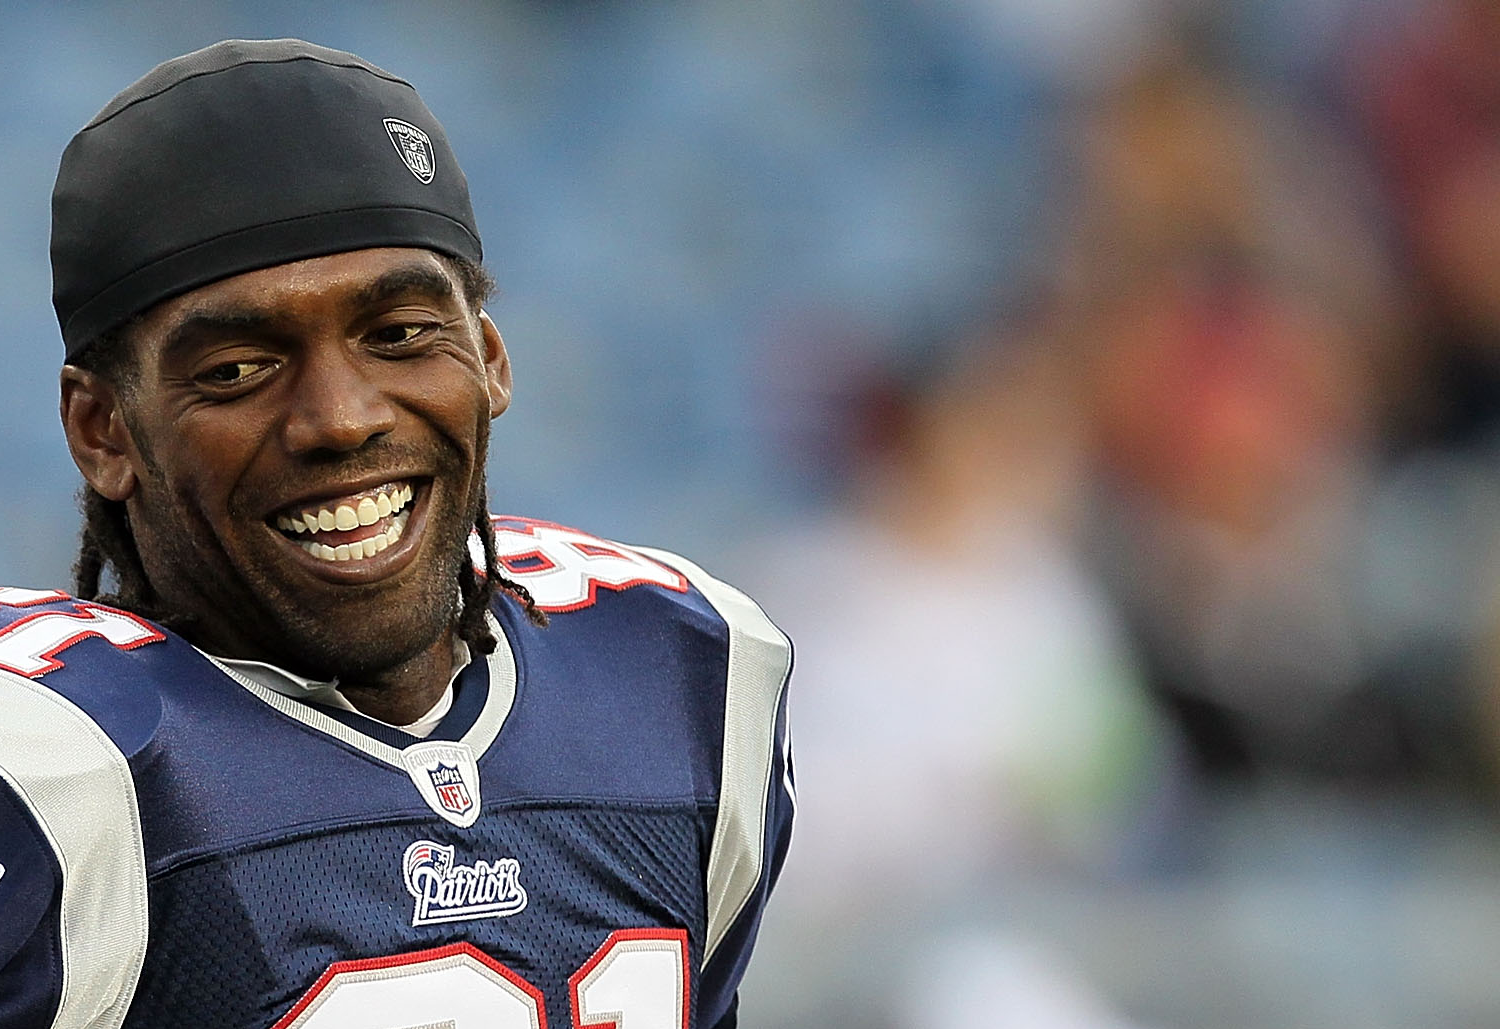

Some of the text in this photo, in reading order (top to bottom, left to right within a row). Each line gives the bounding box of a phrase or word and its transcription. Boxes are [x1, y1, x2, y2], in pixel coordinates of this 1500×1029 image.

[410, 749, 468, 767] EQUIPMENT
[438, 784, 469, 810] NFL
[412, 862, 520, 919] Patriots
